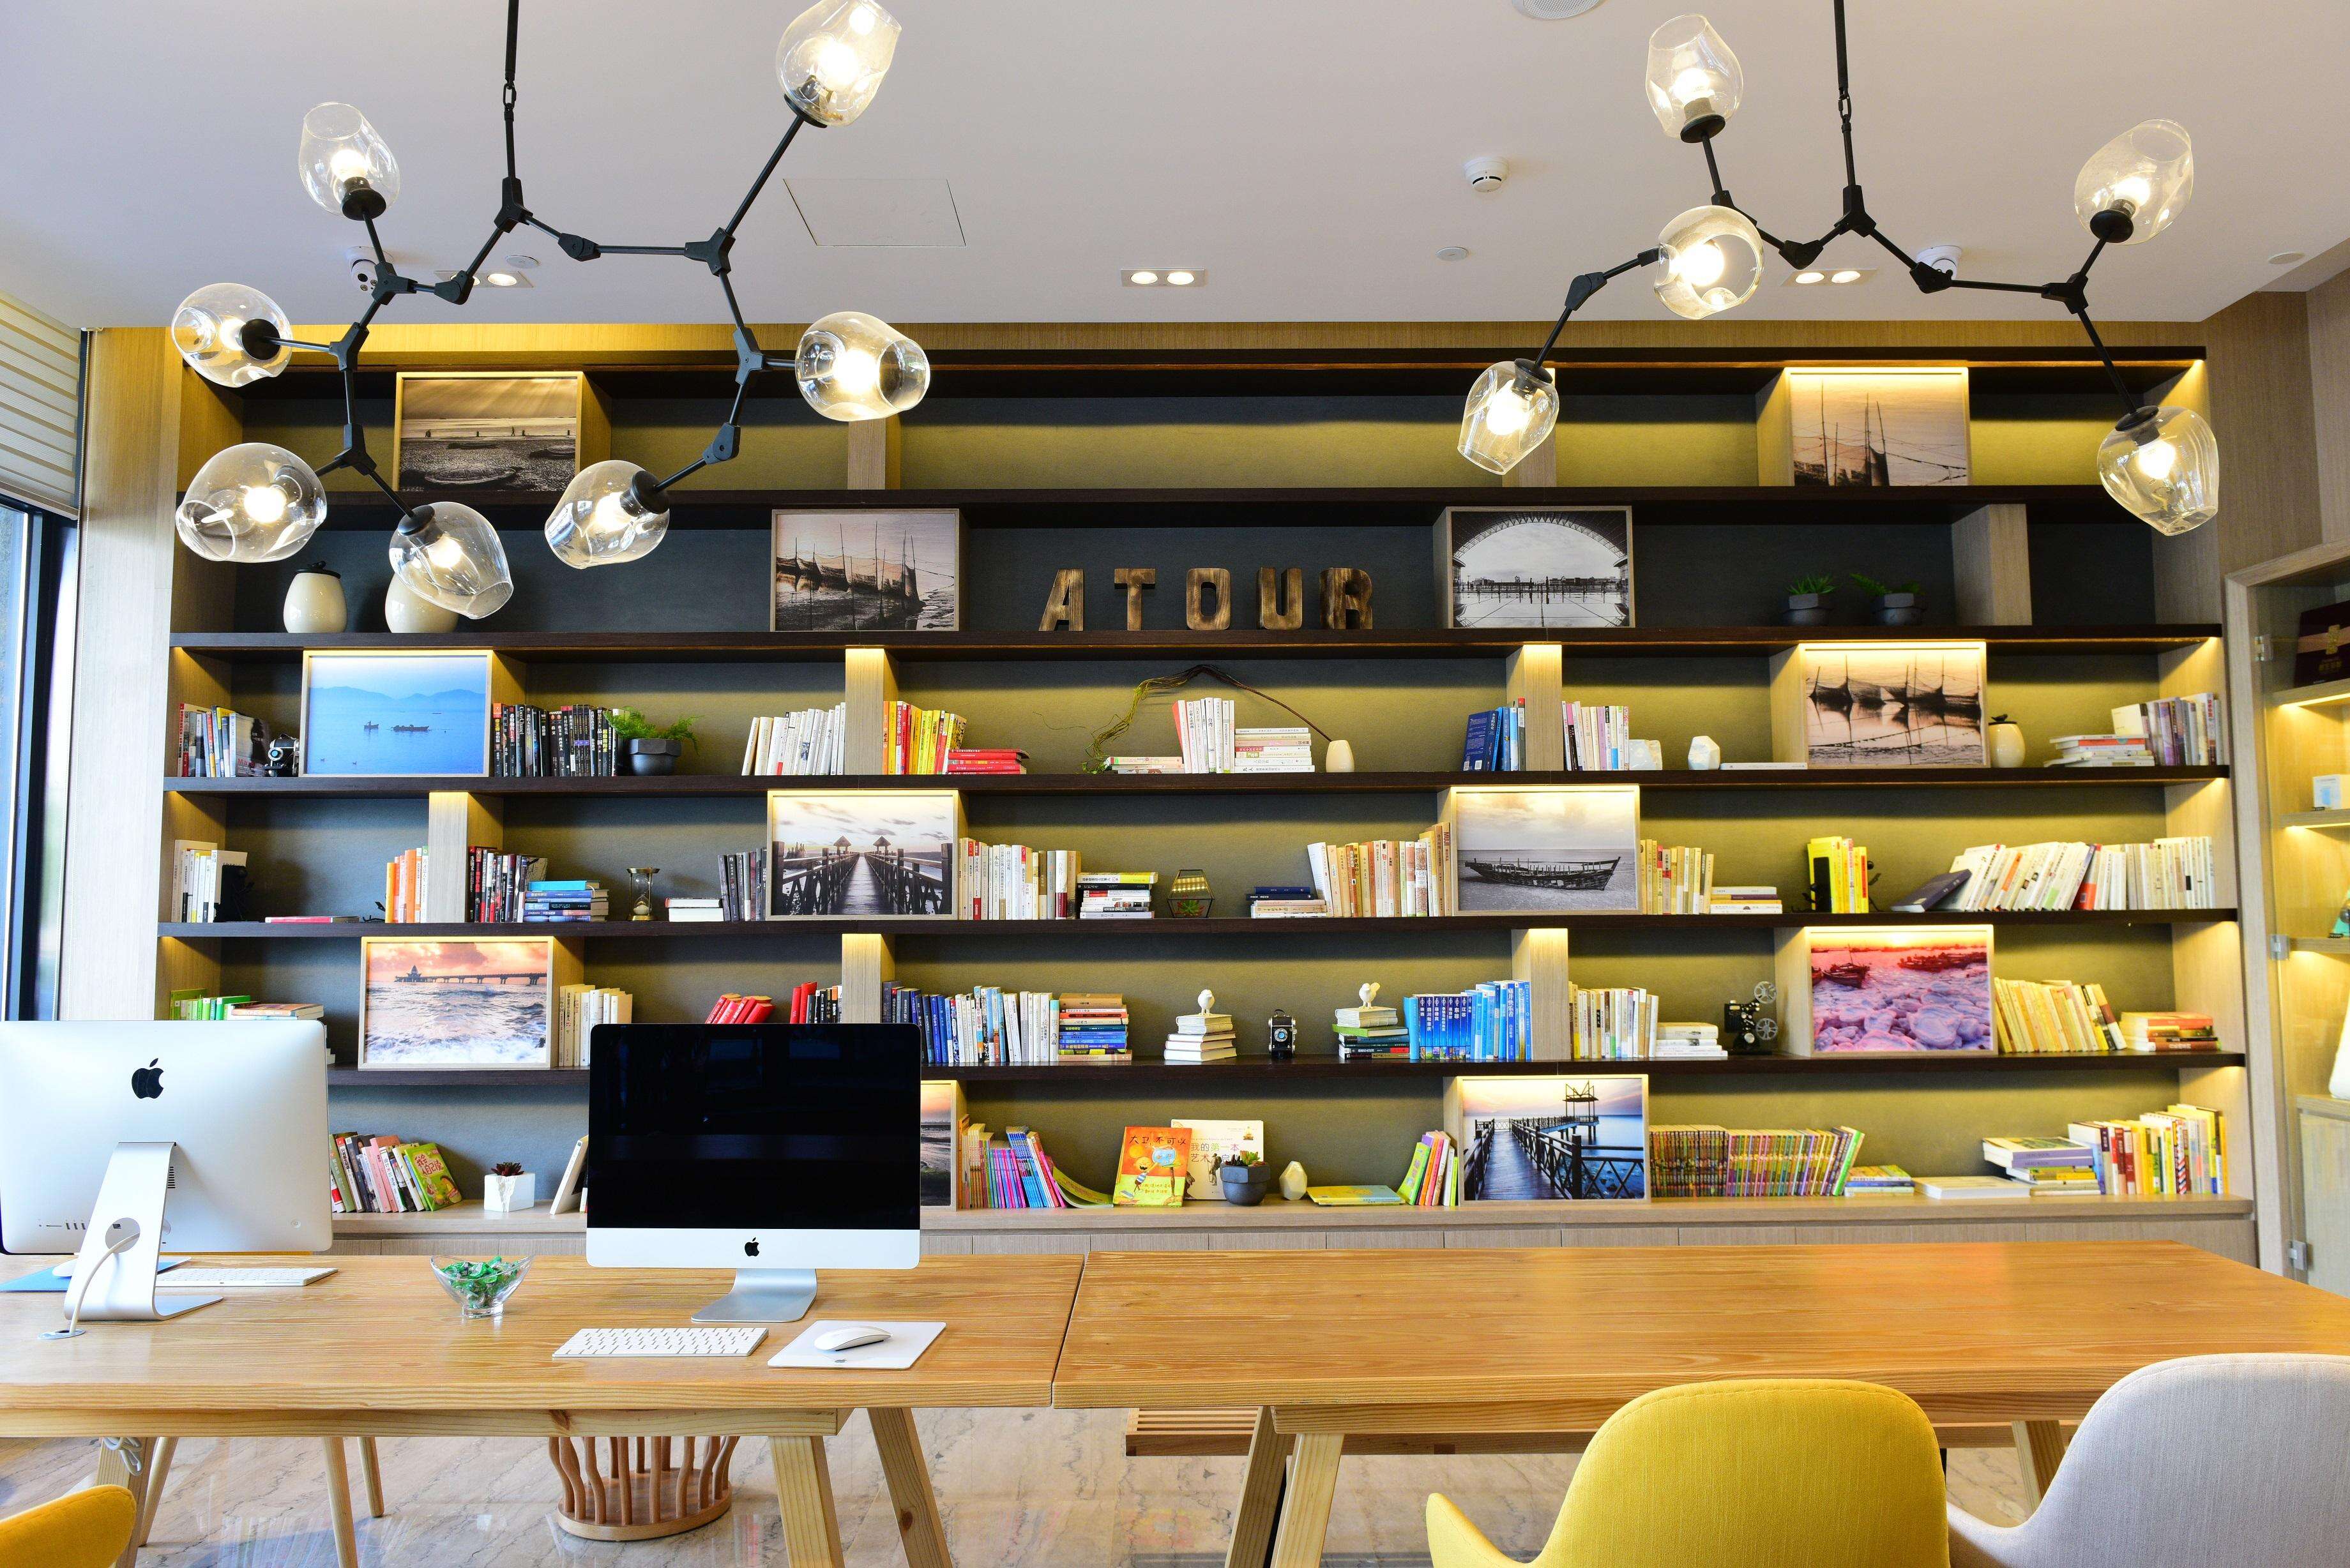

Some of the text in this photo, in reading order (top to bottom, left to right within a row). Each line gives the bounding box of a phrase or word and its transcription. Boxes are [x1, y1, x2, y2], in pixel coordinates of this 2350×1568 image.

[1038, 567, 1373, 631] ATOUR
[1191, 1143, 1239, 1152] 我的第一本
